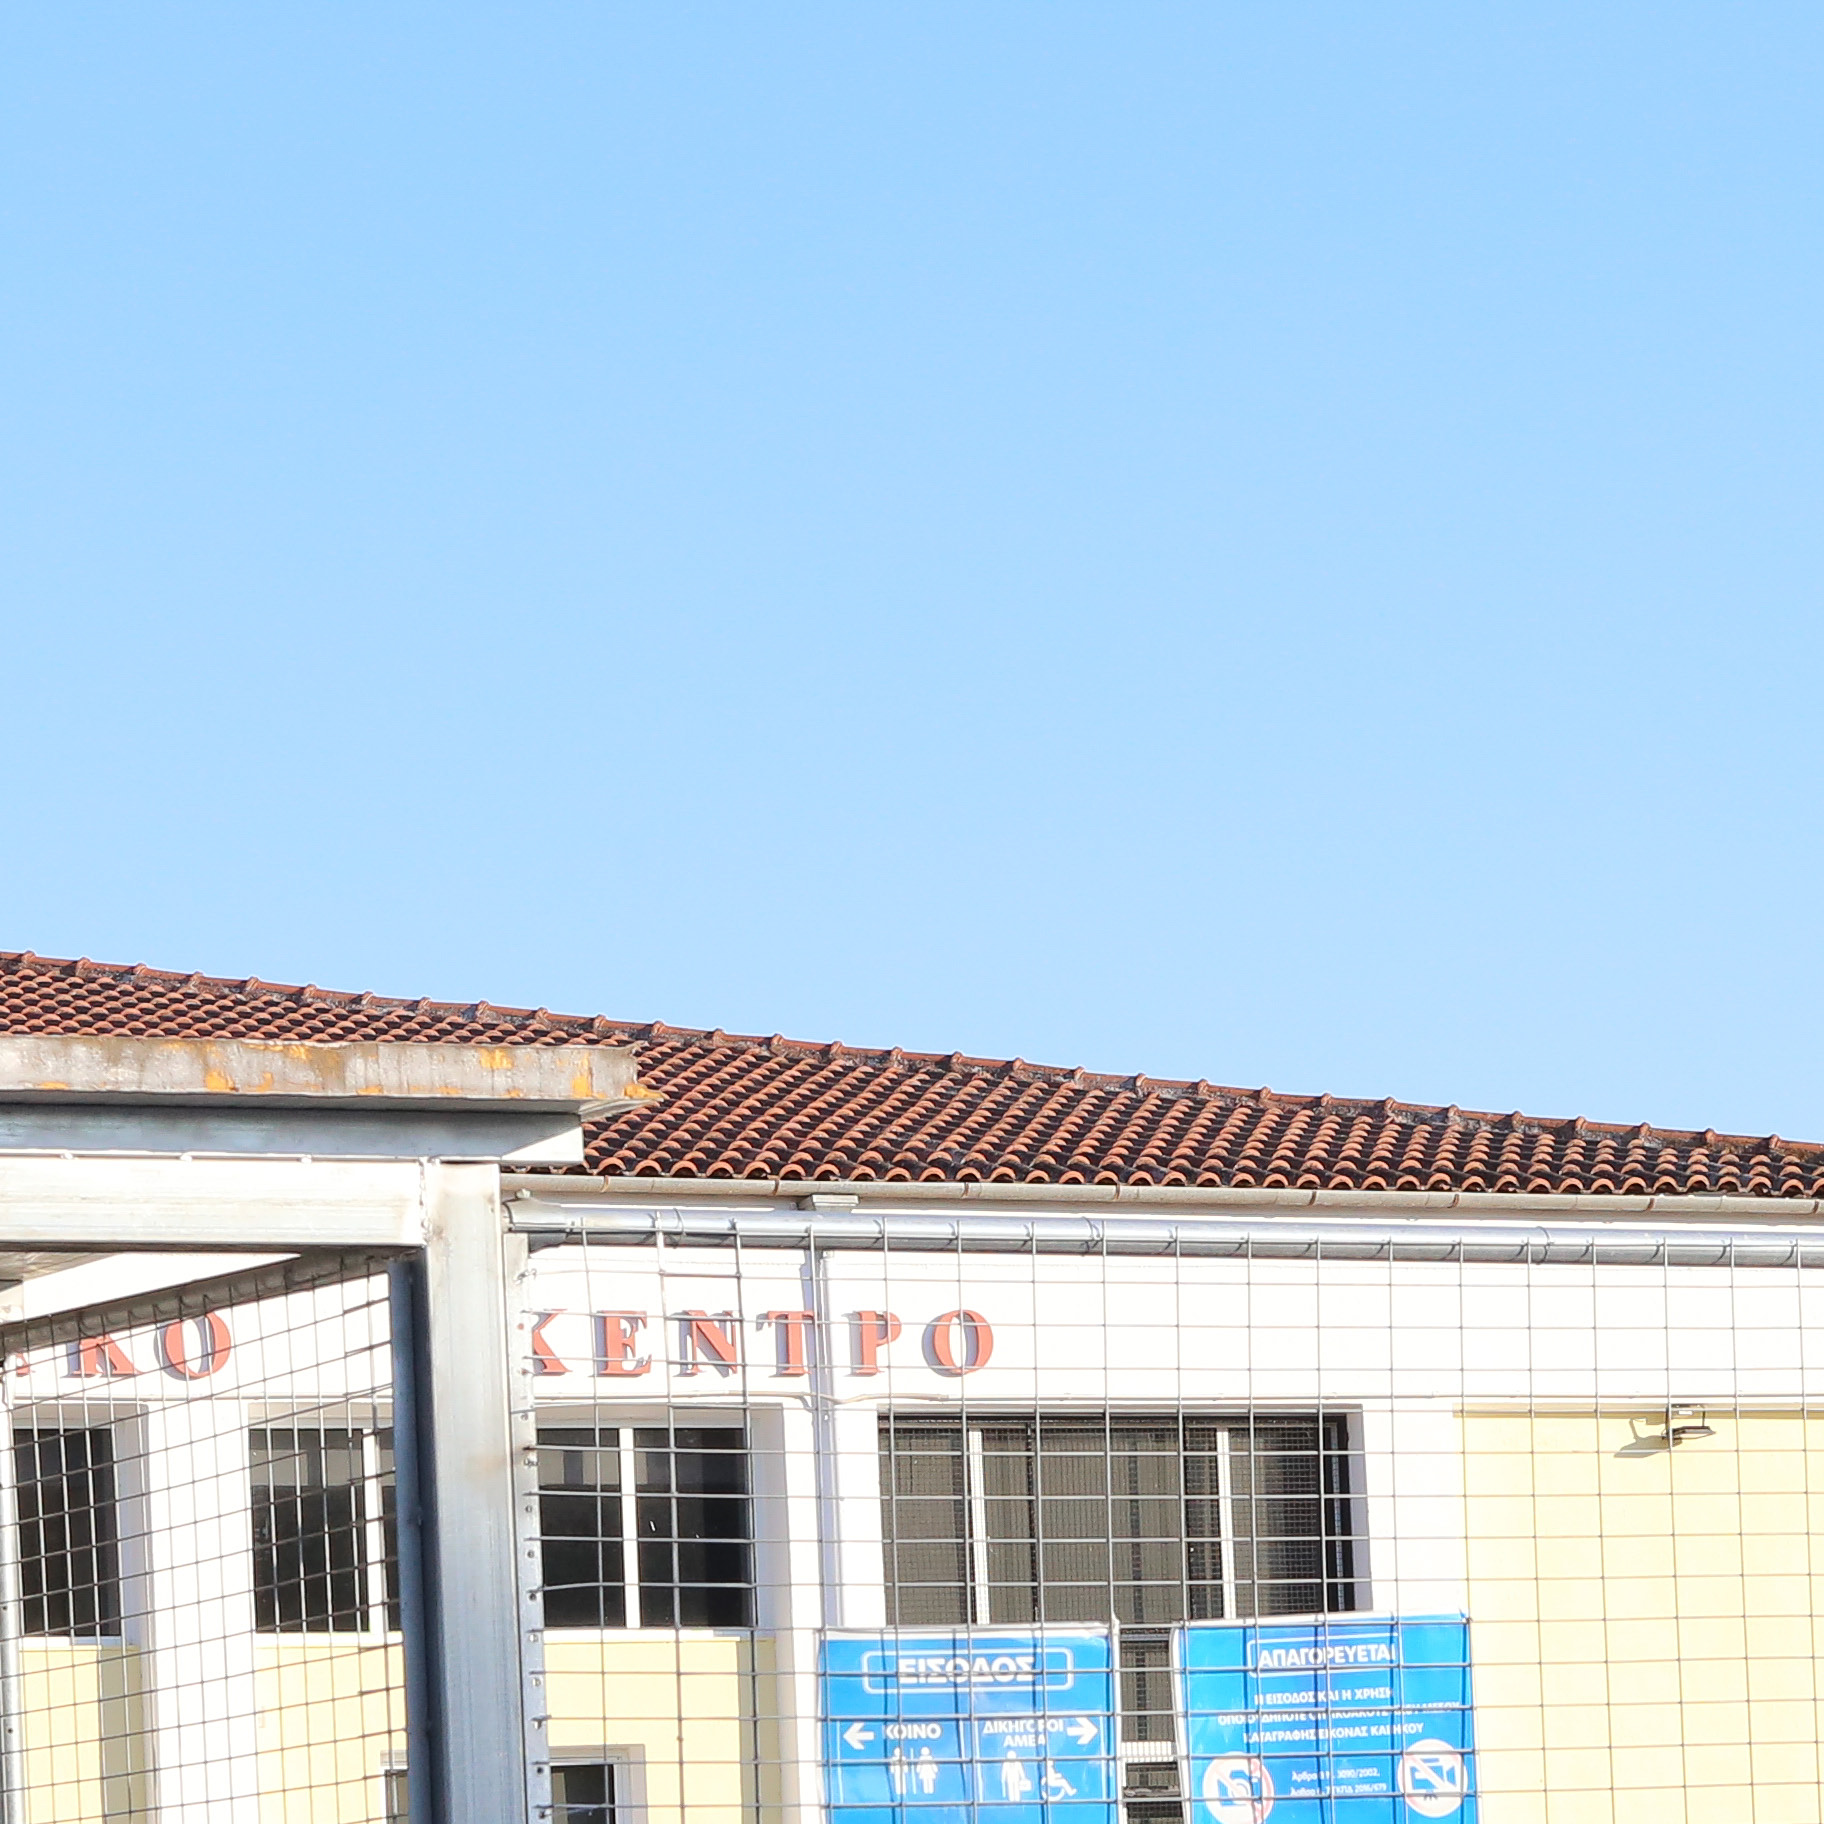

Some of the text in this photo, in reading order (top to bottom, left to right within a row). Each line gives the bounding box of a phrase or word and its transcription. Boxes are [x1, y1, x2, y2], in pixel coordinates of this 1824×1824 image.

[1258, 1643, 1396, 1668] ΑΠΑΓΟΡΕΥΕΤΑΙ
[897, 1656, 1035, 1684] ΕΙΣΟΔΟΣ
[1265, 1690, 1315, 1705] ΕΙΣΟΔΟΣ
[1317, 1688, 1339, 1703] ΚΑΙ
[1341, 1689, 1352, 1700] Η
[1003, 1734, 1046, 1748] ΑΜΕΑ
